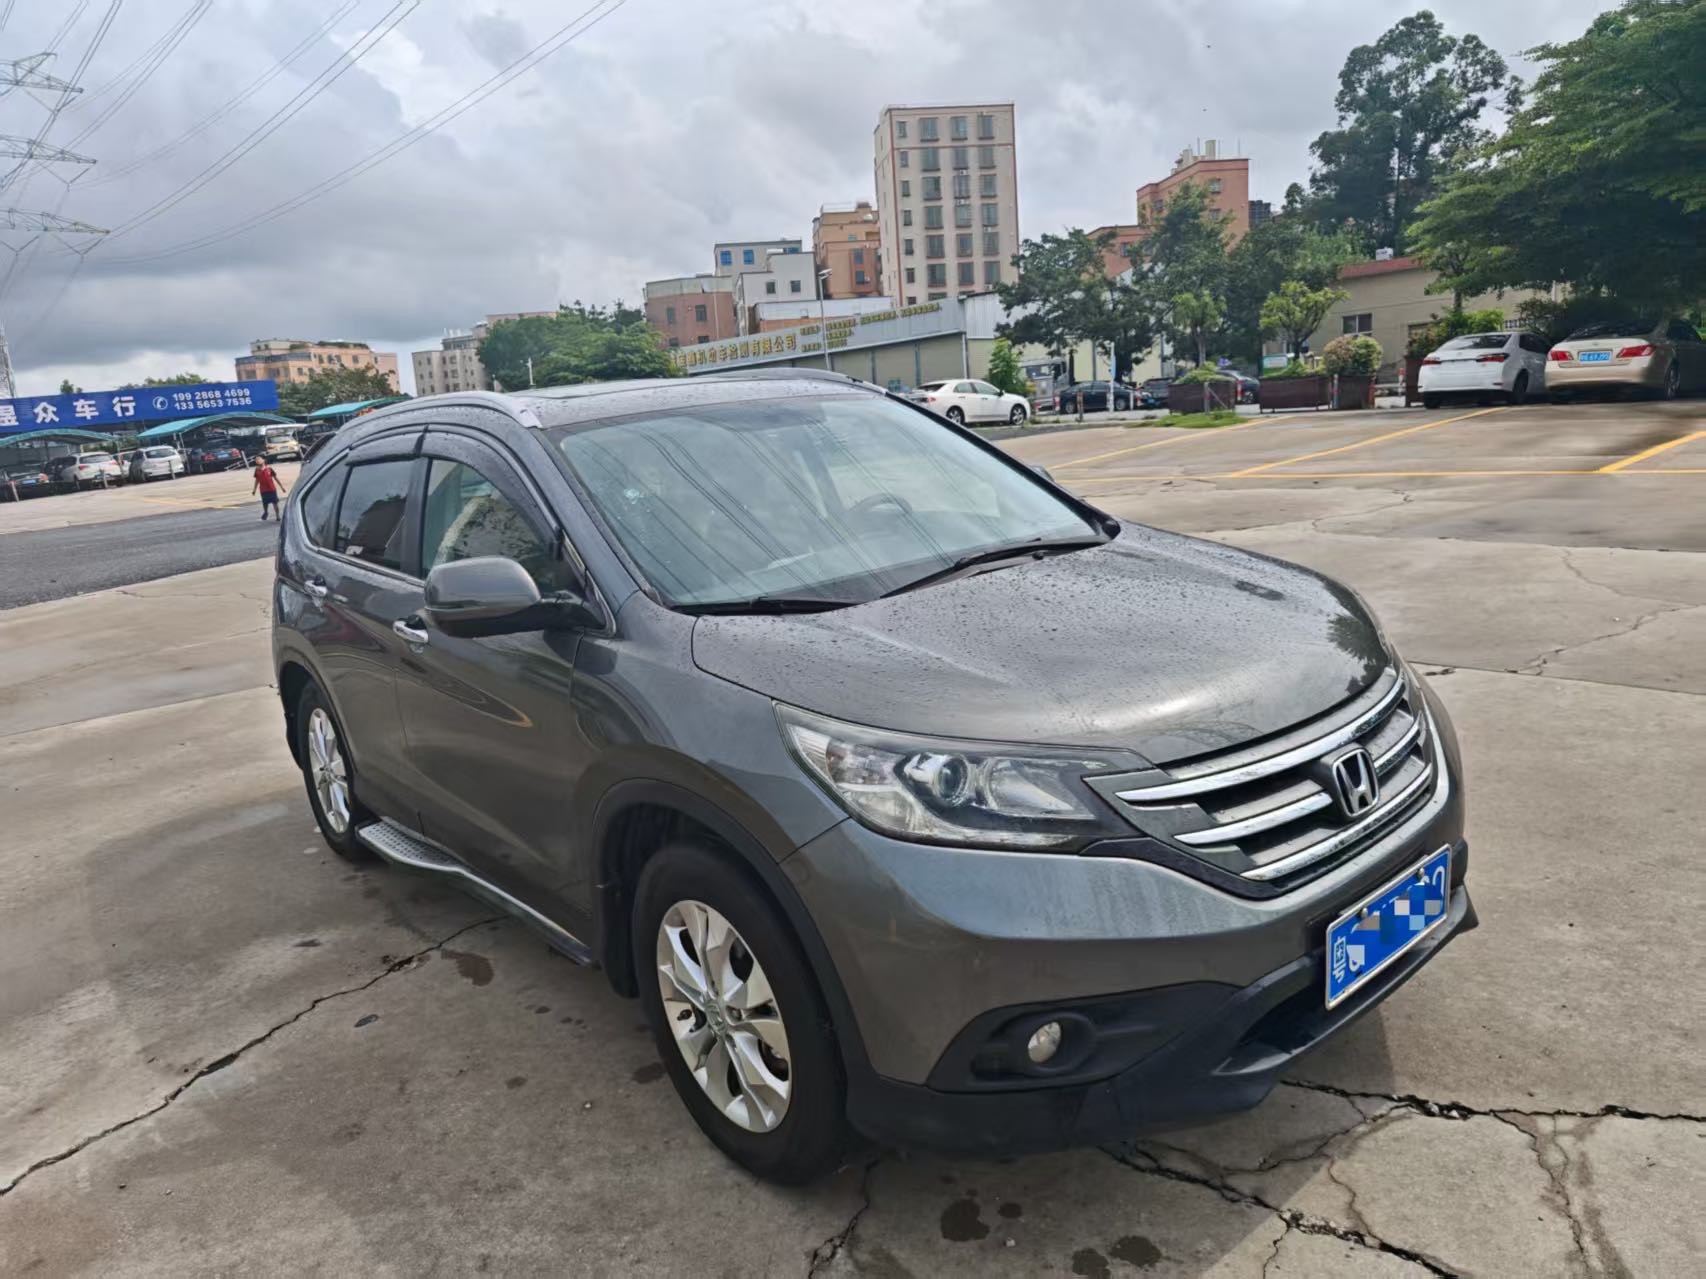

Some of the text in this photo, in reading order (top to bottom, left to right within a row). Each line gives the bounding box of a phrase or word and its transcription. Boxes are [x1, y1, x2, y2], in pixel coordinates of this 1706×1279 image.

[172, 388, 250, 401] 199 2868 4699
[174, 401, 194, 410] 133
[196, 399, 223, 409] 5653
